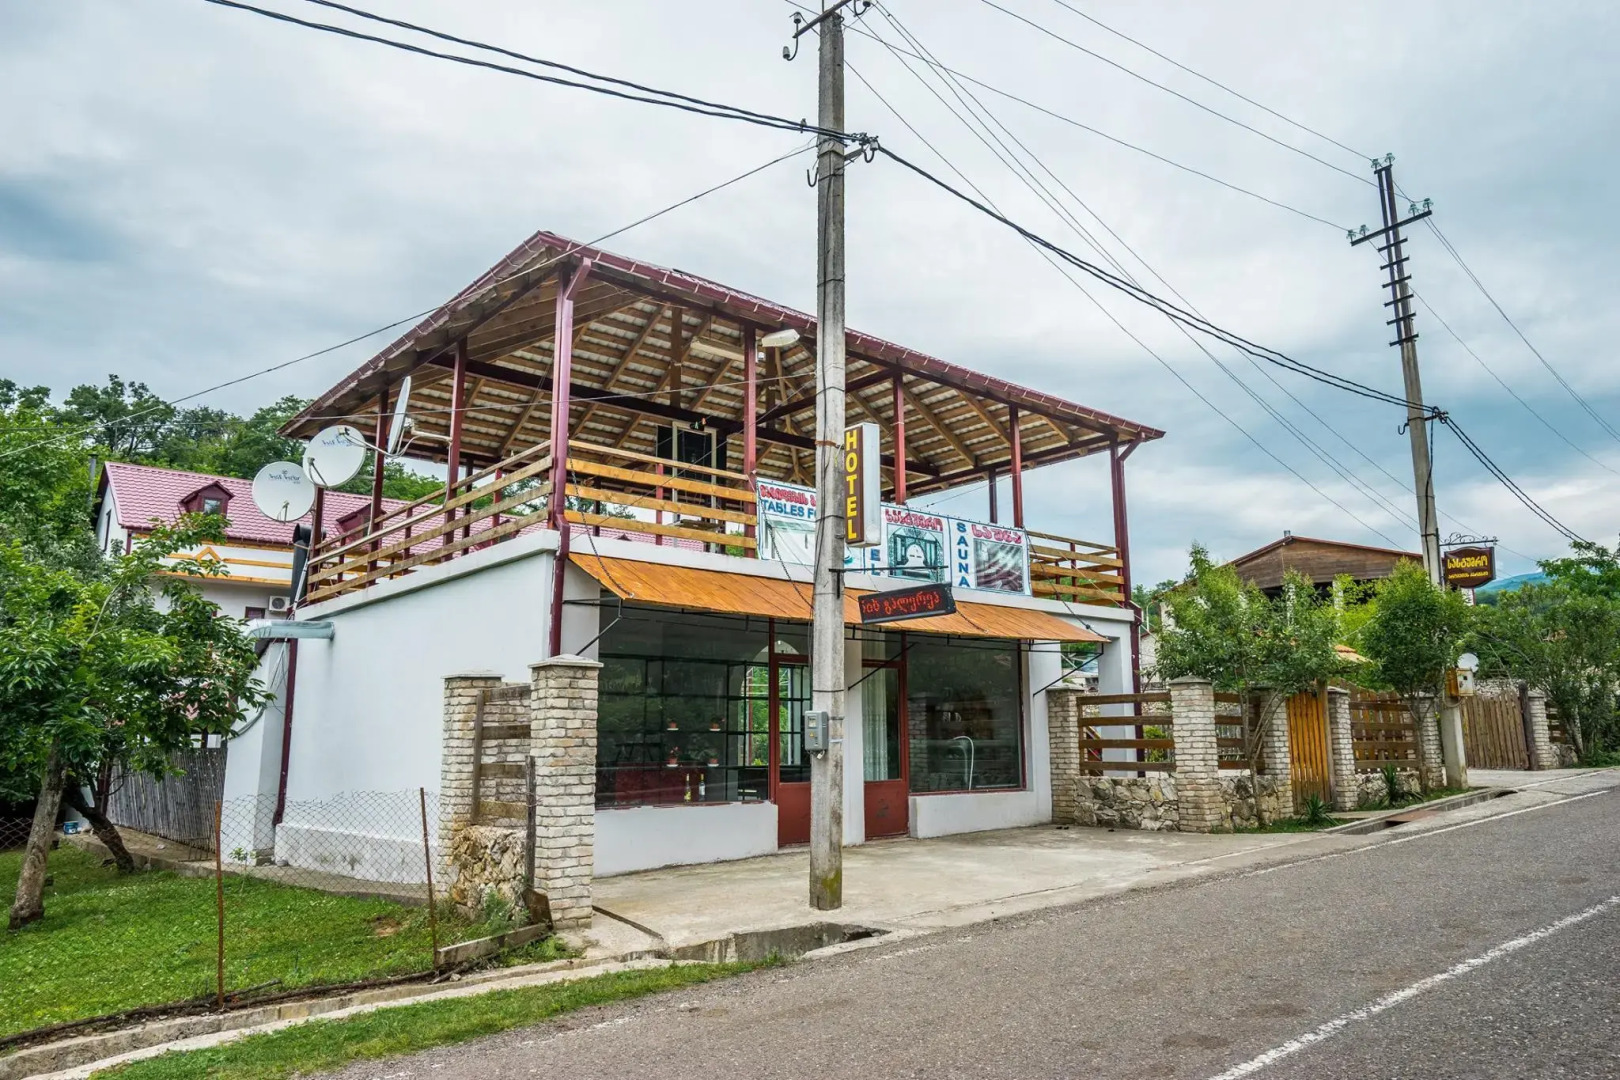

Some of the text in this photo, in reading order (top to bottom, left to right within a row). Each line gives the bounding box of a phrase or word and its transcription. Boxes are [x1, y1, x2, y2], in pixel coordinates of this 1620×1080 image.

[845, 429, 858, 540] HOTEL
[762, 499, 805, 517] TABLES
[956, 522, 970, 587] SAUNA
[1447, 555, 1488, 569] სასტუმრო
